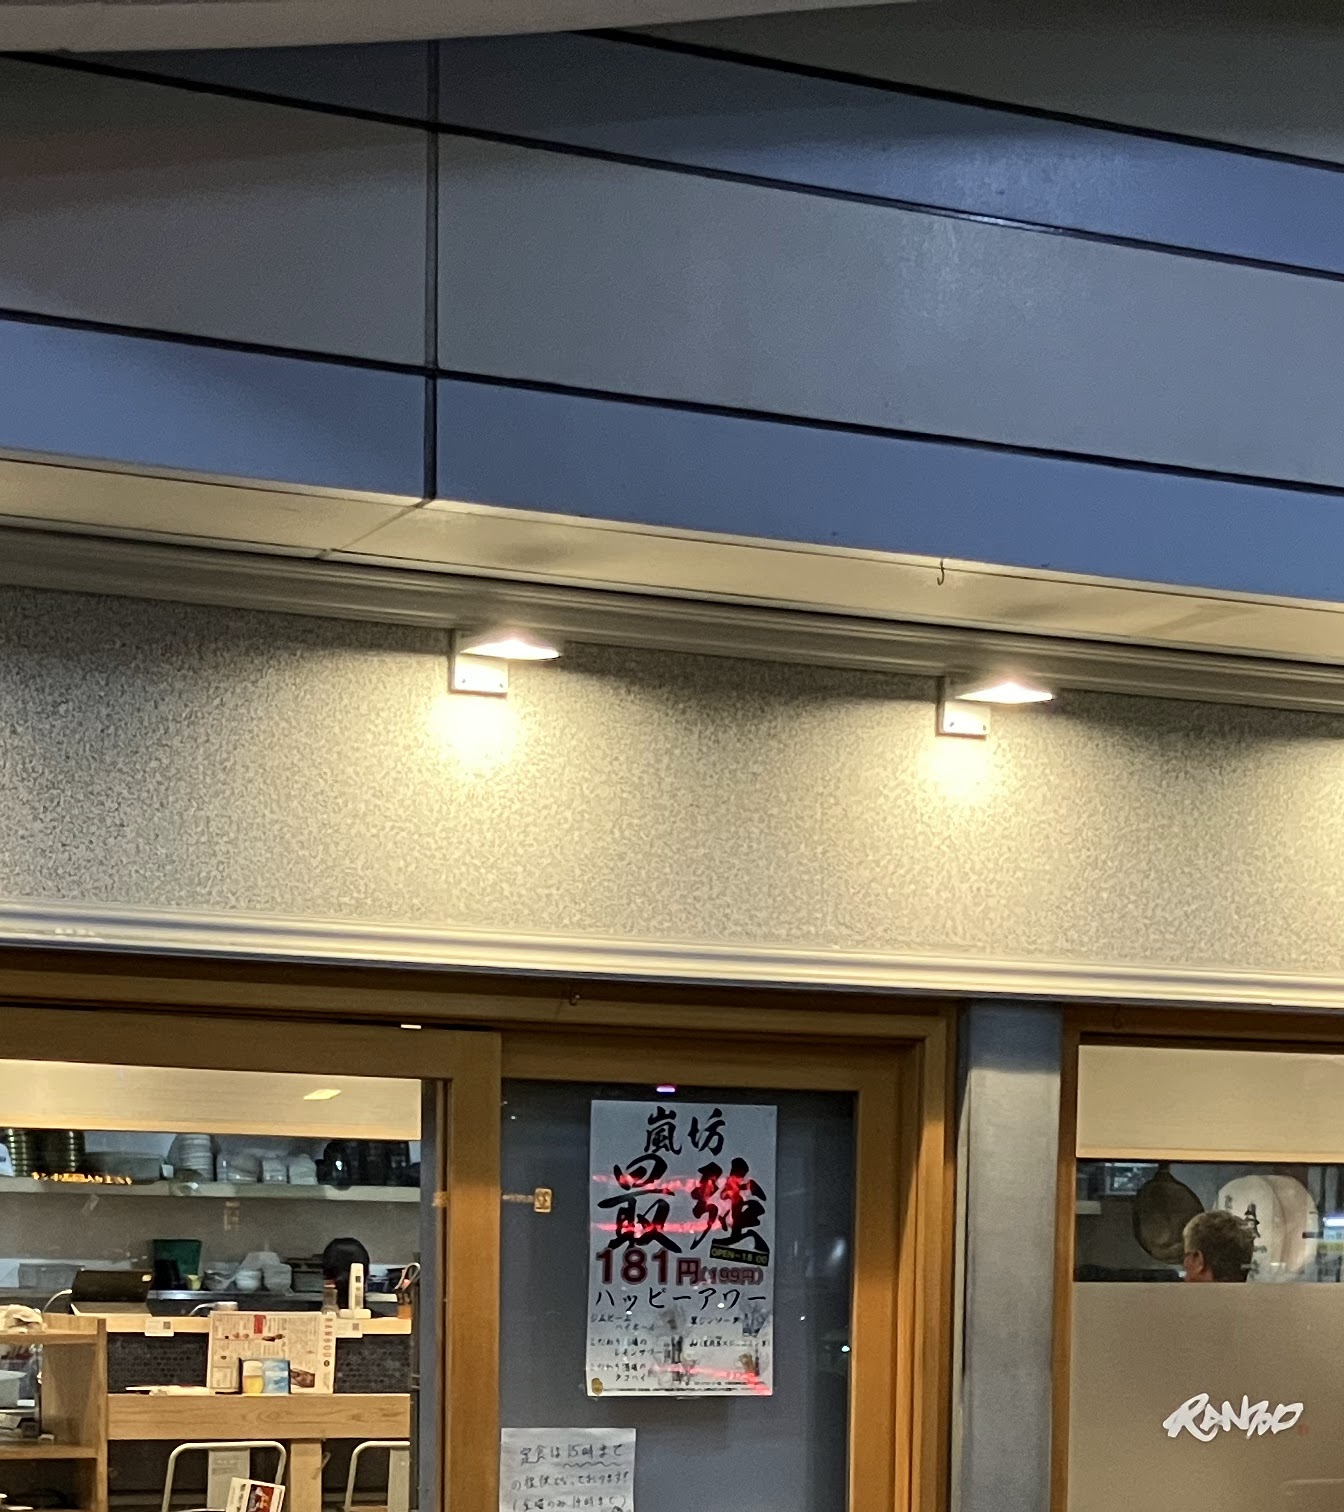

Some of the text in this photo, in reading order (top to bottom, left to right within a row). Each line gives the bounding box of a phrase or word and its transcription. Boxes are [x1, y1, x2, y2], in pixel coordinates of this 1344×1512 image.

[643, 1105, 727, 1156] 嵐坊
[597, 1155, 771, 1253] 最強
[595, 1286, 767, 1310] ハッピーアワー
